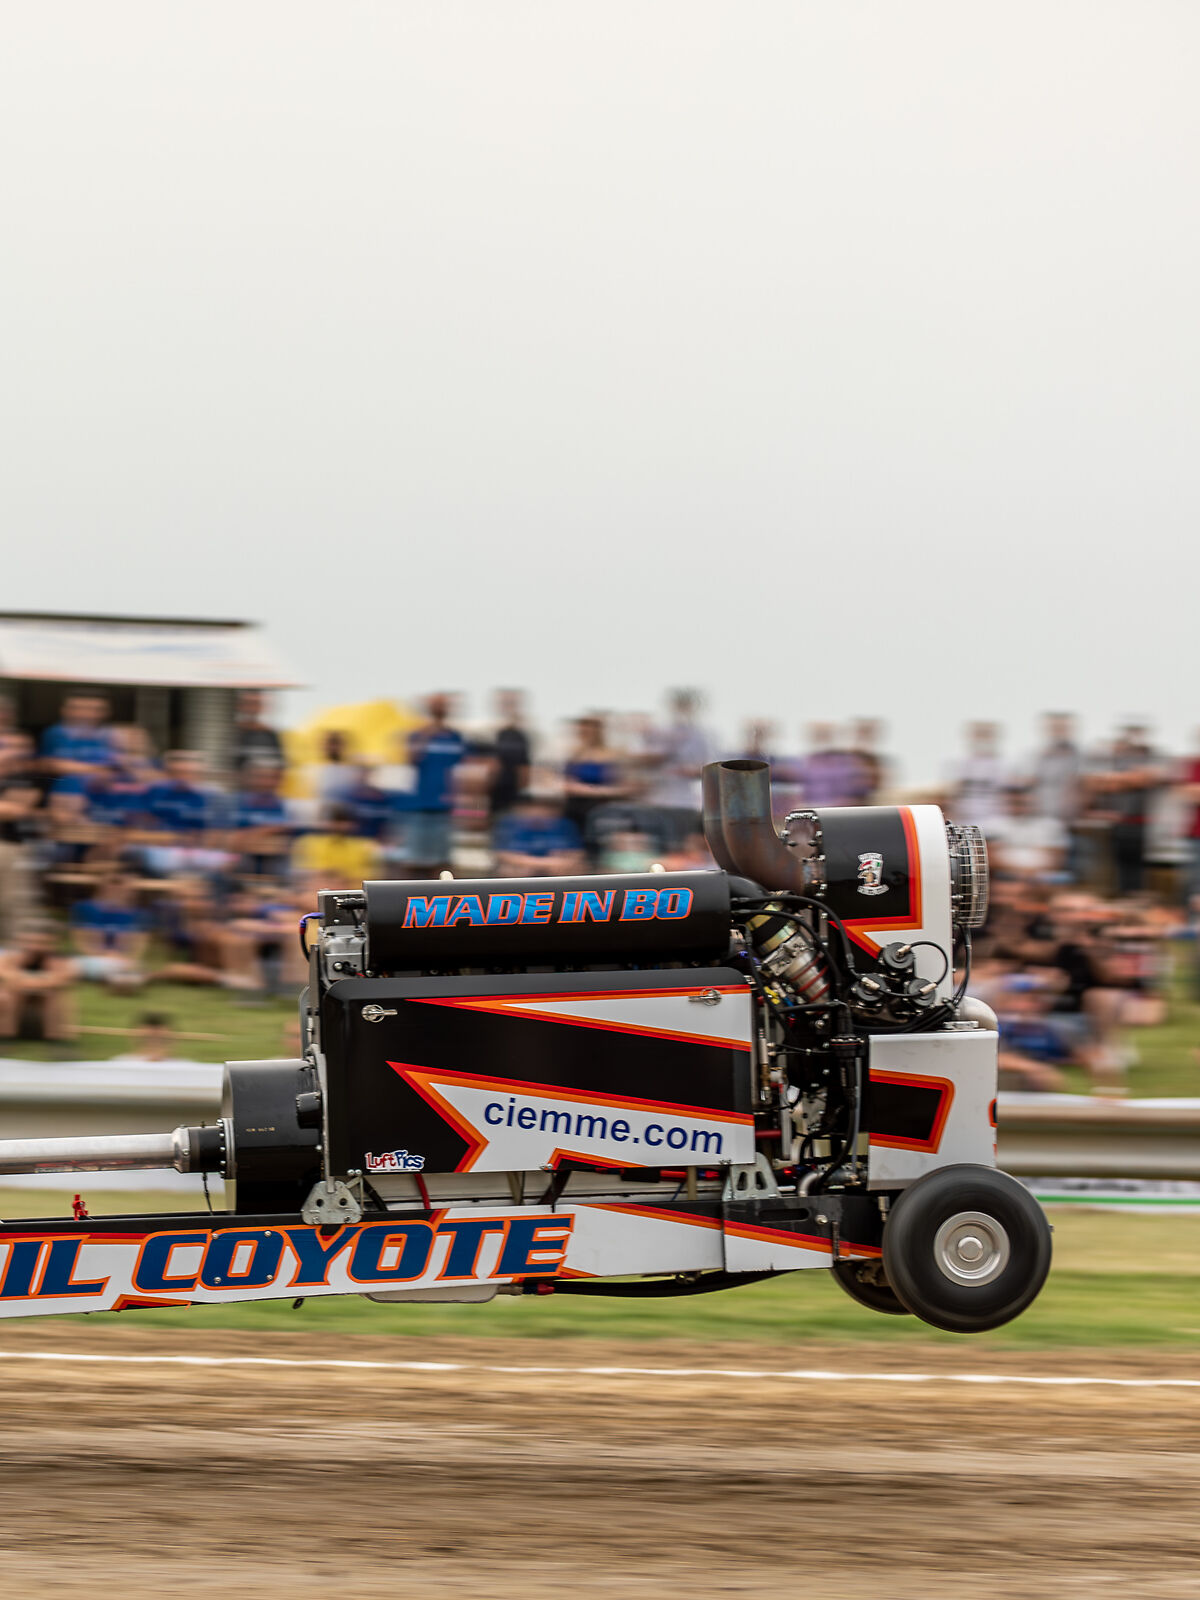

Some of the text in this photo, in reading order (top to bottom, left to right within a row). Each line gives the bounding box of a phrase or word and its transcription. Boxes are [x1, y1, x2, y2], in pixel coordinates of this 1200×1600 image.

[401, 887, 694, 928] MADE IN BO
[484, 1098, 723, 1154] ciemme.com
[131, 1213, 575, 1293] COYOTE
